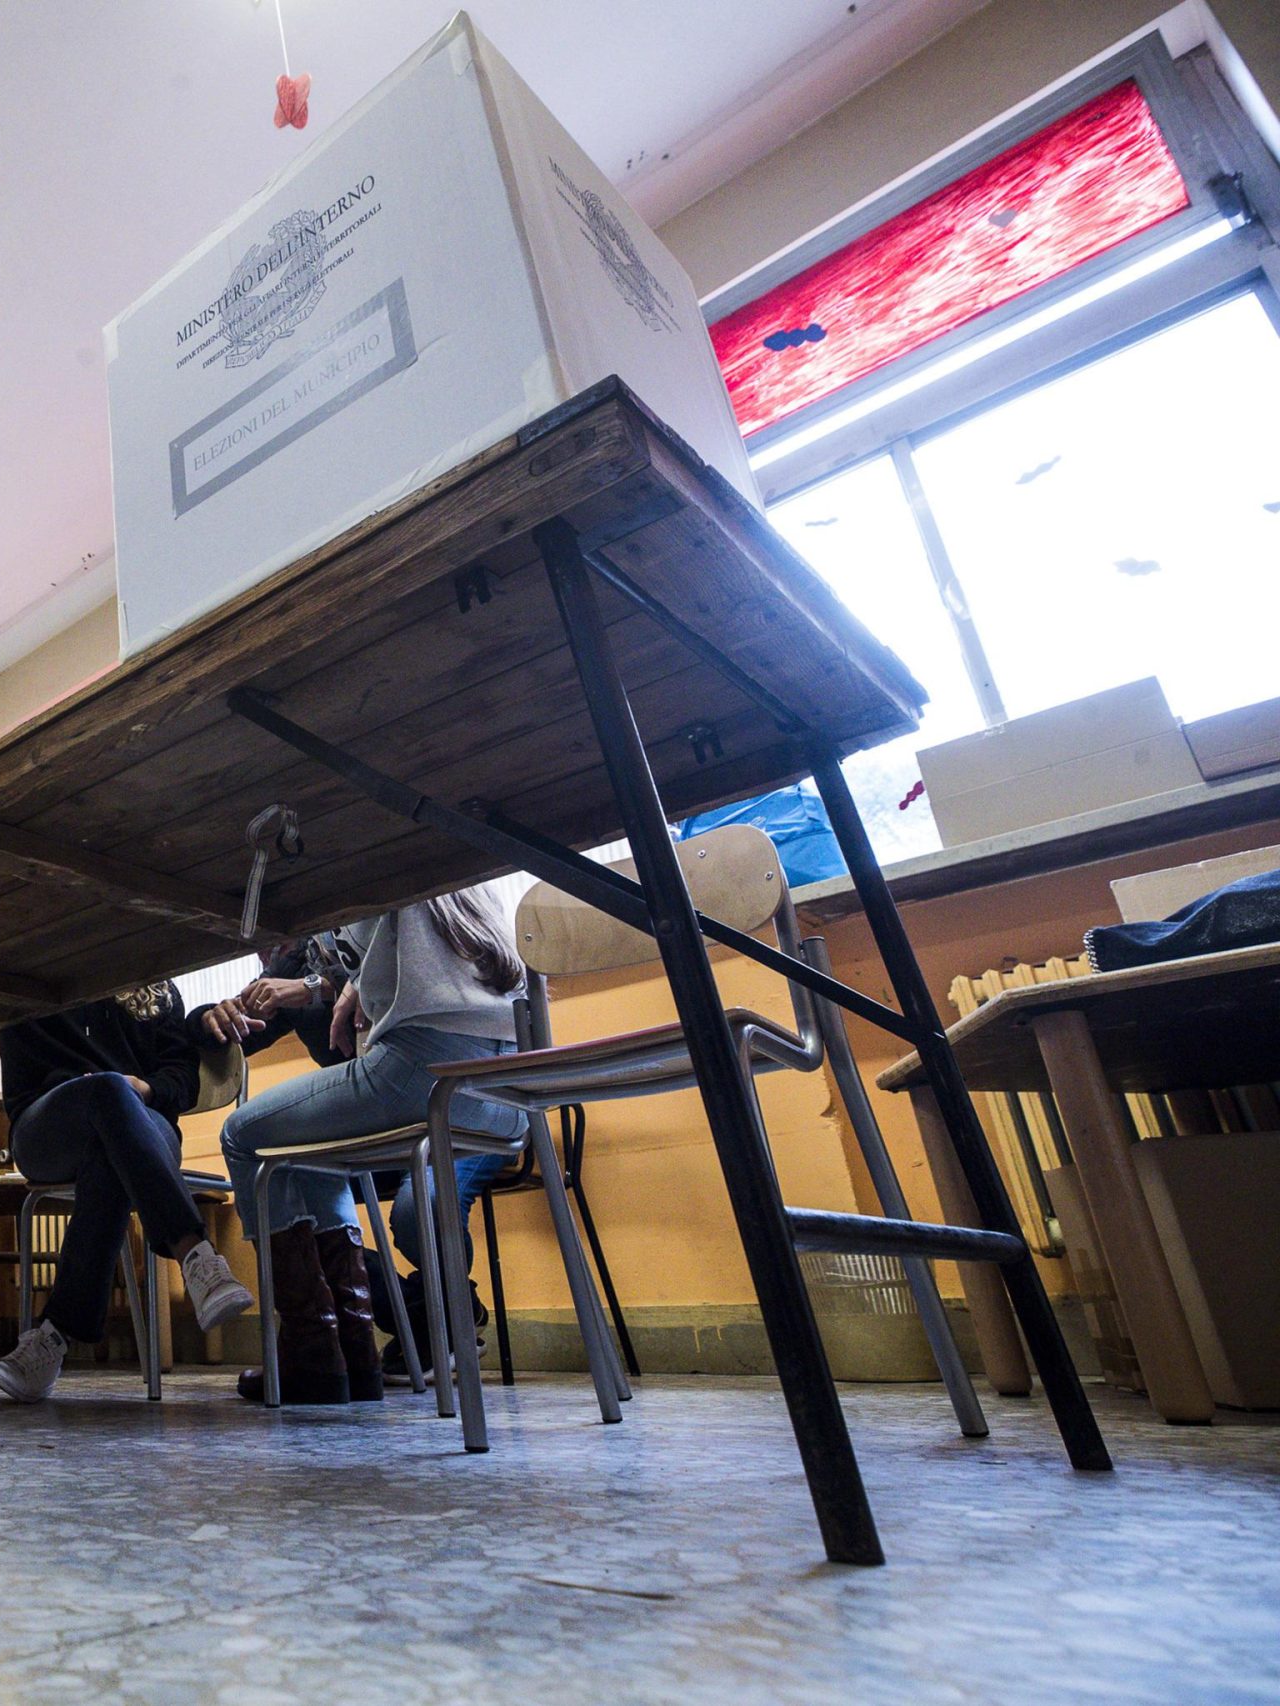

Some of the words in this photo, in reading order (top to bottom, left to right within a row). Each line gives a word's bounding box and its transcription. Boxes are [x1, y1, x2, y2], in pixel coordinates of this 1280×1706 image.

[176, 275, 253, 347] MINISTERO
[256, 175, 375, 282] DELL'INTERNO
[176, 322, 228, 369] DIPARTIMENTO
[325, 203, 382, 252] TERRITORIALI
[312, 248, 354, 284] ELETTORALI
[193, 416, 257, 471] ELEZIONI
[261, 397, 291, 426] DEL
[294, 334, 380, 403] MUNICIPIO
